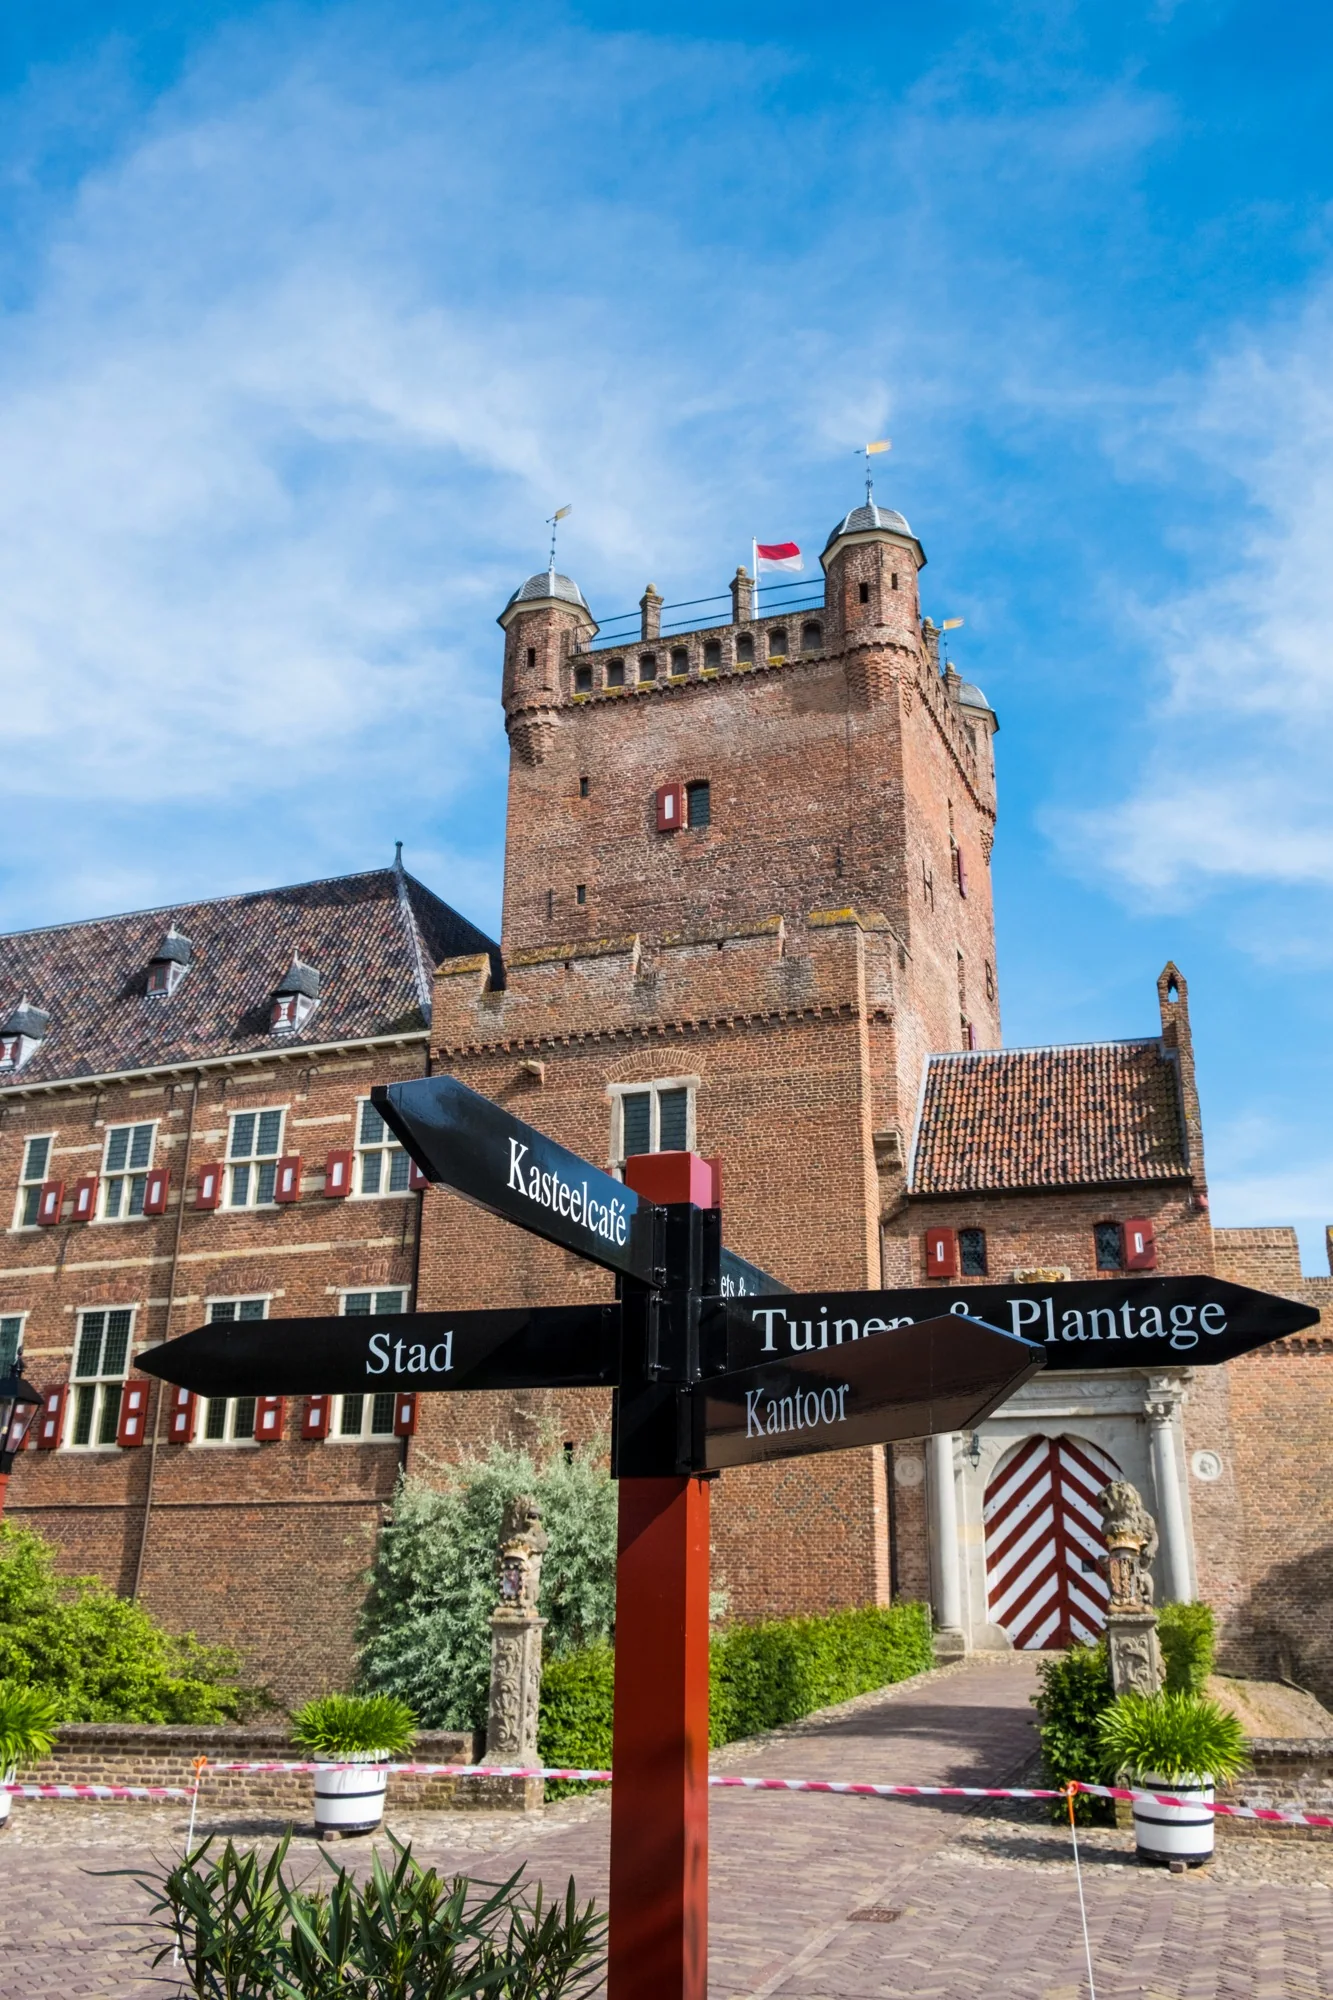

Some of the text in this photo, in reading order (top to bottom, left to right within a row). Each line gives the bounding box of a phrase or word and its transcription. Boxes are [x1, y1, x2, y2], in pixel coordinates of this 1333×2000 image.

[506, 1137, 626, 1246] Kasteelcafé
[719, 1273, 735, 1298] ets
[1006, 1297, 1228, 1350] Plantage
[365, 1330, 454, 1375] Stad
[744, 1383, 850, 1439] Kantoor
